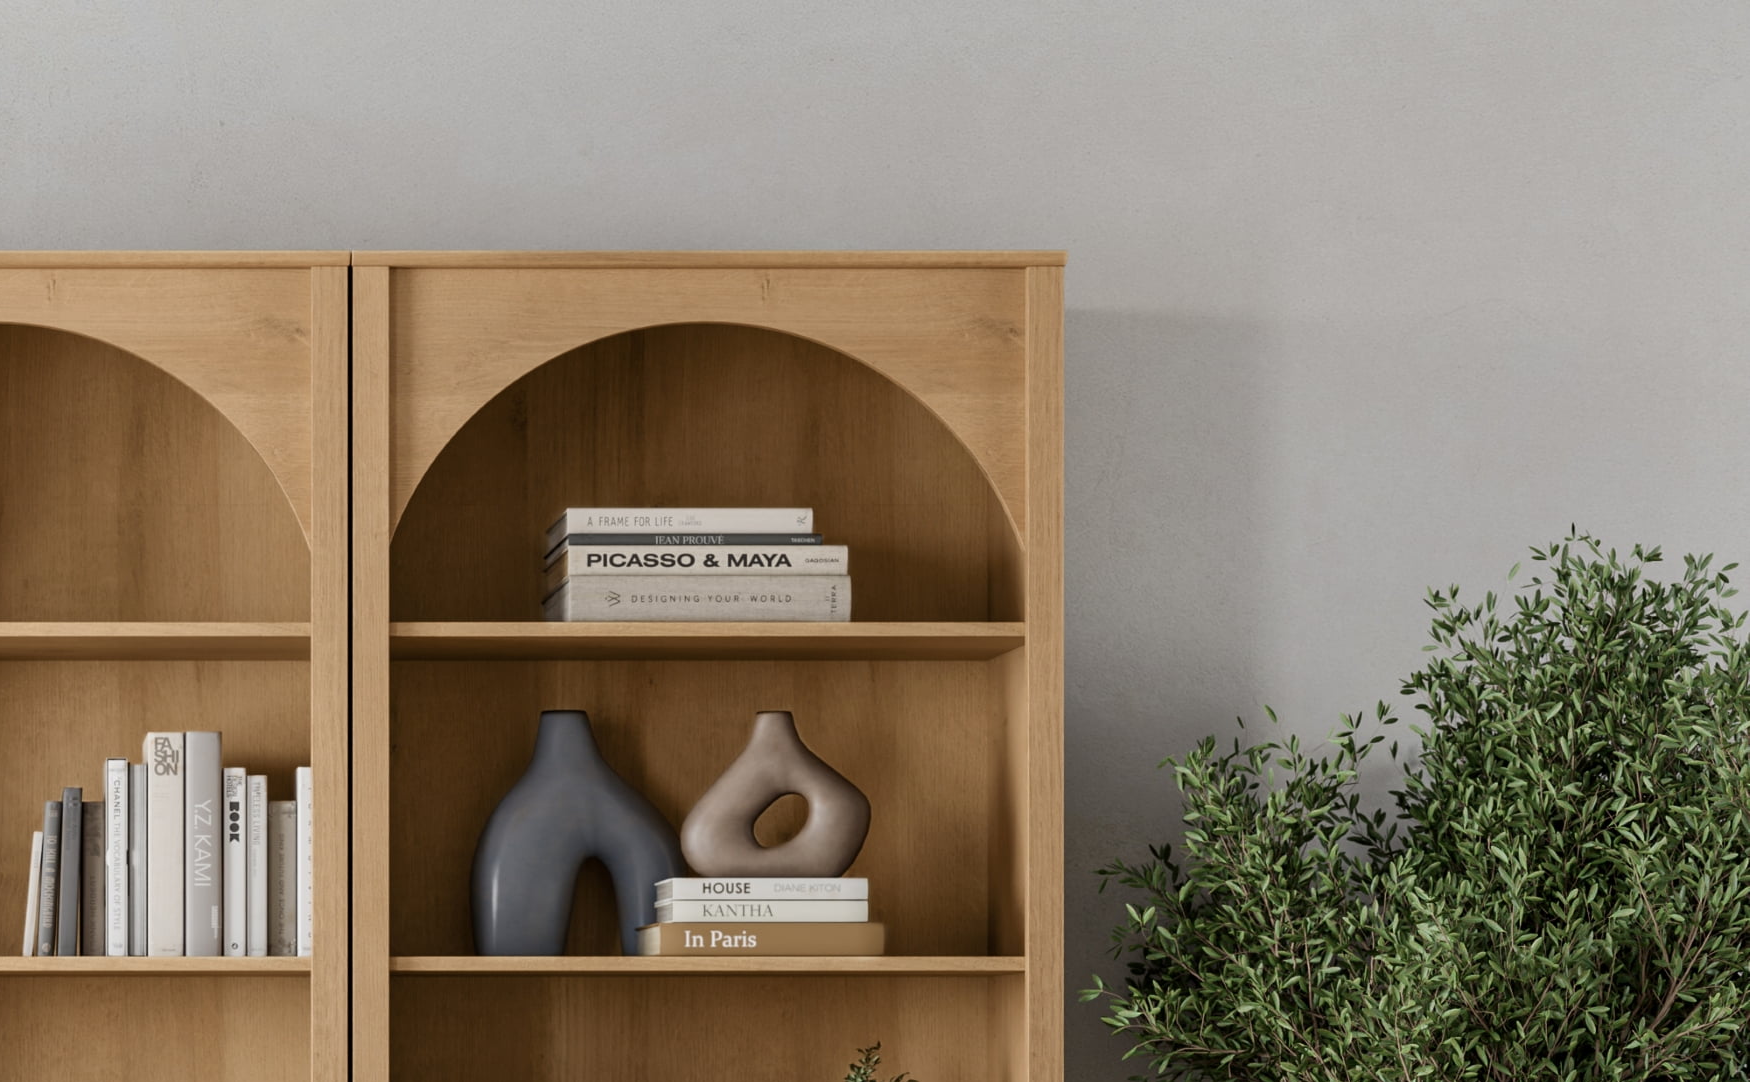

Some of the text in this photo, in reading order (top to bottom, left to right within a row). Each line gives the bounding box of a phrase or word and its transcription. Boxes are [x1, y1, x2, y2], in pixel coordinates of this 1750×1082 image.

[587, 516, 594, 527] A
[599, 516, 630, 527] FRAME
[634, 516, 651, 527] FOR
[655, 516, 674, 527] LIFE
[586, 553, 792, 568] PICASSO & MAYA
[631, 595, 793, 603] DESIGNING YOUR WORLD
[252, 782, 261, 818] TIMELESS
[230, 802, 240, 842] BOOK
[252, 821, 261, 846] LIVING
[194, 800, 212, 886] Y.Z. KAMI
[702, 882, 751, 894] HOUSE
[774, 884, 806, 893] DIANE
[114, 894, 120, 904] OF
[702, 904, 774, 918] KANTHA
[684, 930, 757, 948] In Paris
